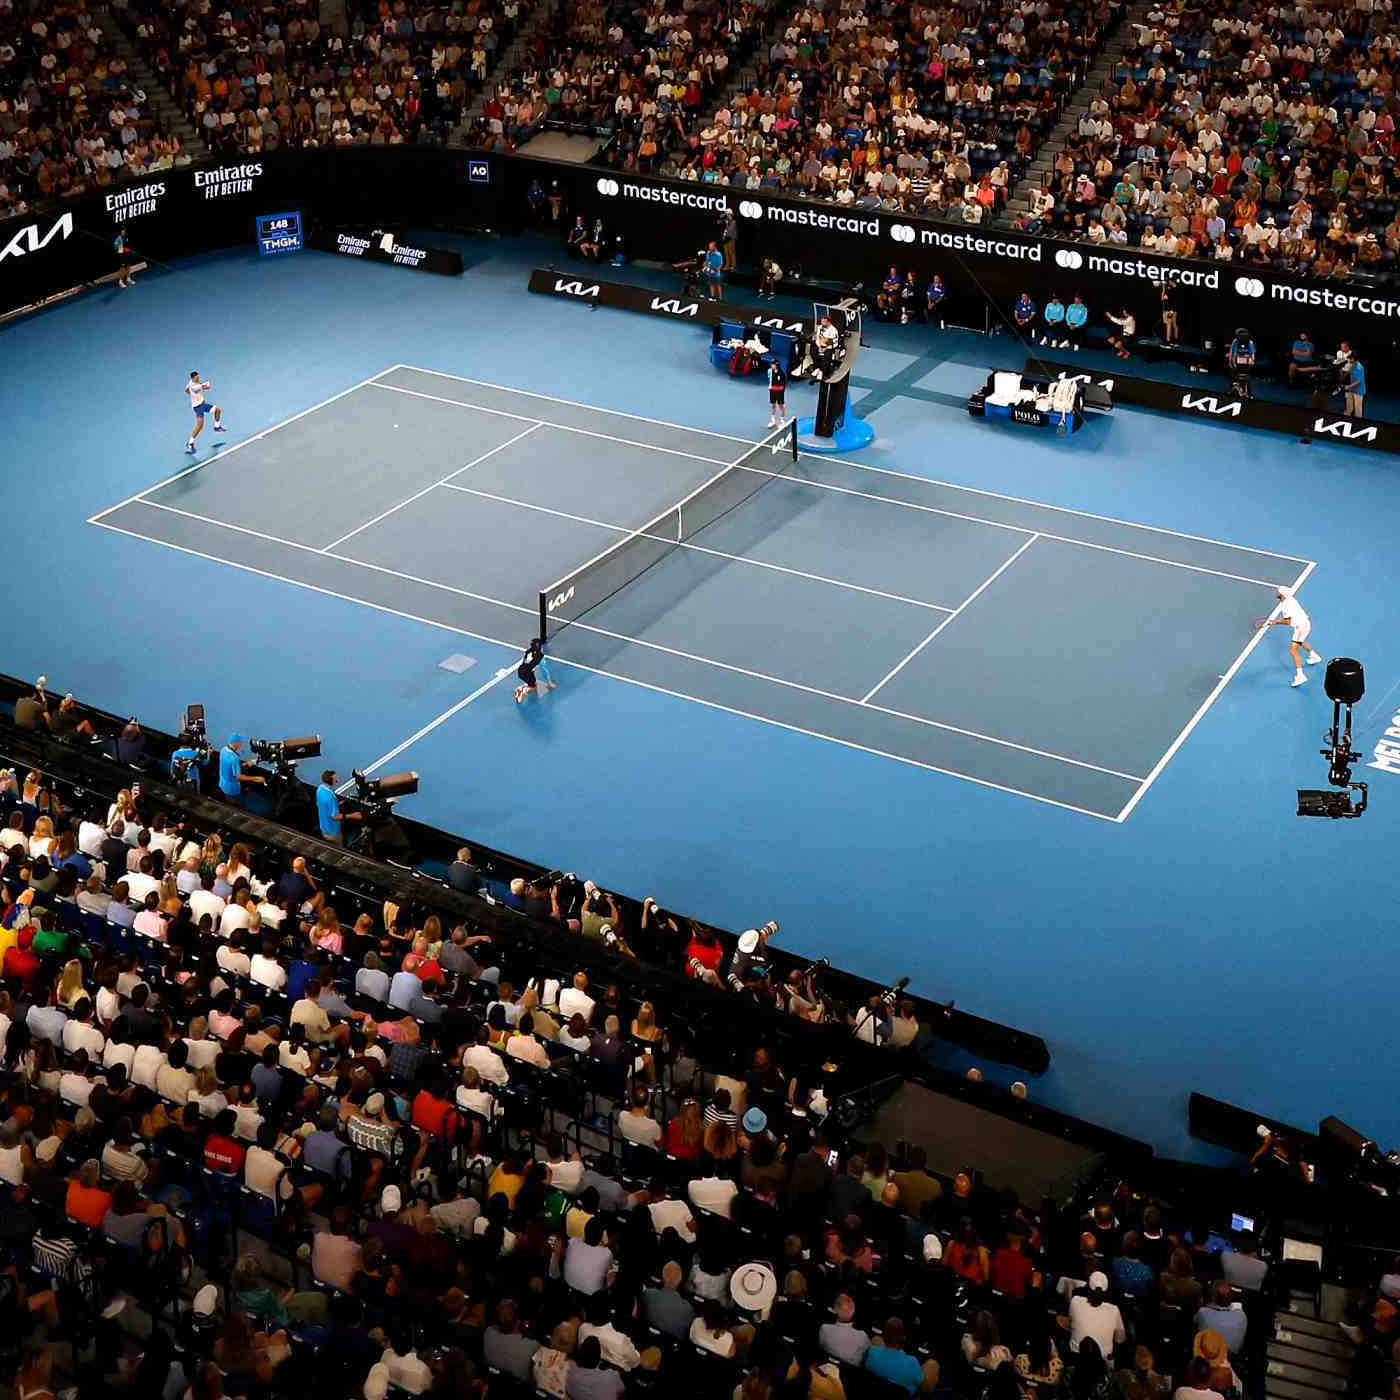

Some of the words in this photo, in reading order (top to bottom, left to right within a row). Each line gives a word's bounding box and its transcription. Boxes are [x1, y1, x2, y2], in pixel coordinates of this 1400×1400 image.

[194, 163, 262, 187] Emirates
[472, 166, 486, 175] AO
[105, 182, 165, 211] Emirates
[205, 184, 219, 199] FLY
[221, 178, 253, 196] BETTER
[623, 182, 727, 212] mastercard
[114, 209, 127, 223] FLY
[129, 199, 156, 217] BETTER
[768, 205, 880, 236] mastercard
[270, 219, 288, 230] 148
[337, 233, 370, 248] Emirates
[392, 244, 426, 259] Emirates
[921, 229, 1041, 261] mastercard
[1089, 255, 1219, 289] mastercard
[555, 279, 600, 297] KIA
[651, 297, 699, 317] KIA
[1182, 393, 1242, 417] KIA
[1314, 417, 1378, 442] KIA
